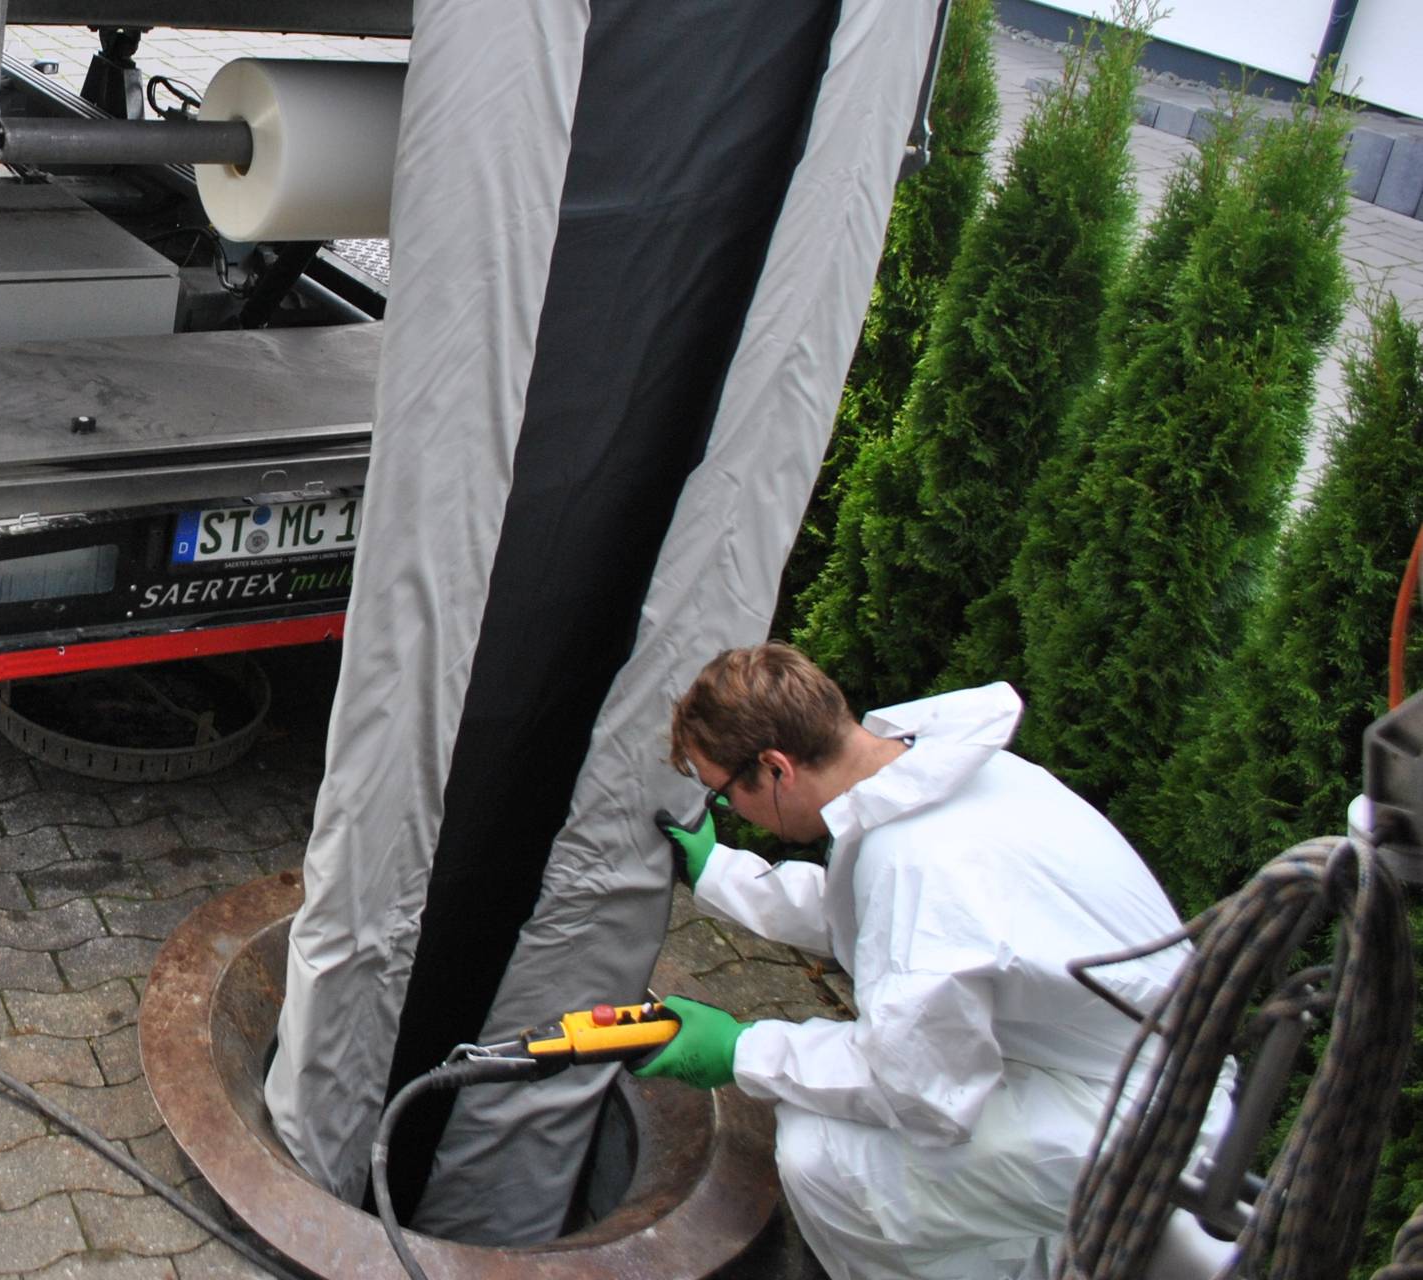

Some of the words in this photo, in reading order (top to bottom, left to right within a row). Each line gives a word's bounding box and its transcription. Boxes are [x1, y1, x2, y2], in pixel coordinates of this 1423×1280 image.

[200, 510, 251, 554] ST
[278, 503, 326, 548] MC
[335, 501, 355, 542] 1
[178, 541, 189, 554] D
[139, 571, 283, 608] SAERTEX
